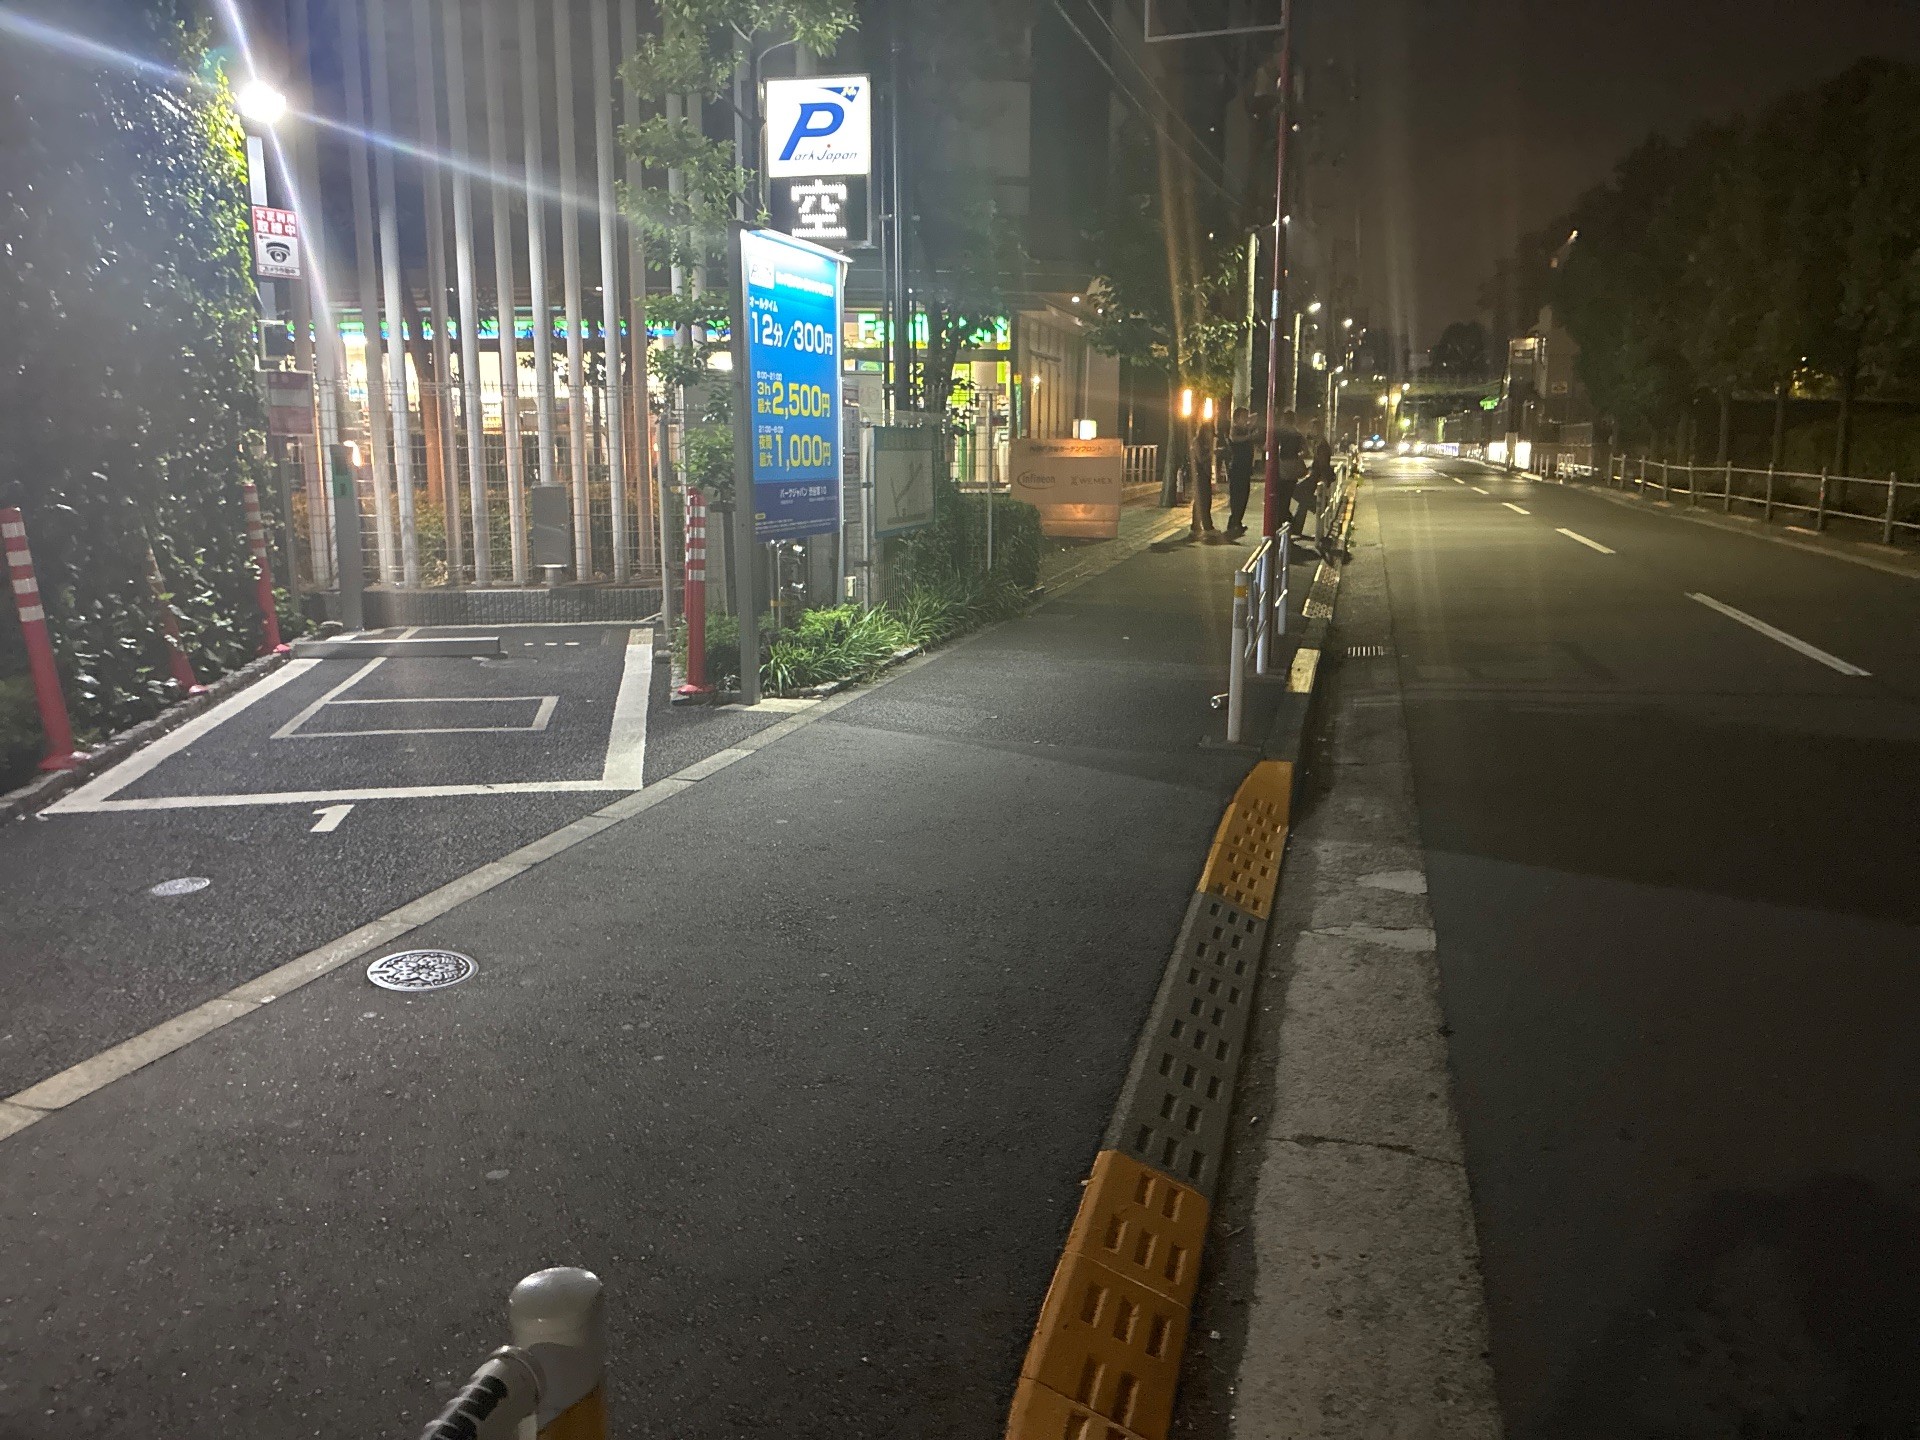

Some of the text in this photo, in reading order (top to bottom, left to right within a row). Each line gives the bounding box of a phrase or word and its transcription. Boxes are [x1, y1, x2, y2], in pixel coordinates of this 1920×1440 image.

[791, 179, 847, 237] 空
[749, 296, 779, 313] オールタイム
[757, 381, 771, 396] 3h
[757, 398, 772, 414] 最大
[772, 381, 830, 420] 2,500円
[759, 451, 773, 468] 最大
[775, 434, 831, 472] 1,000円
[310, 804, 356, 833] 1
